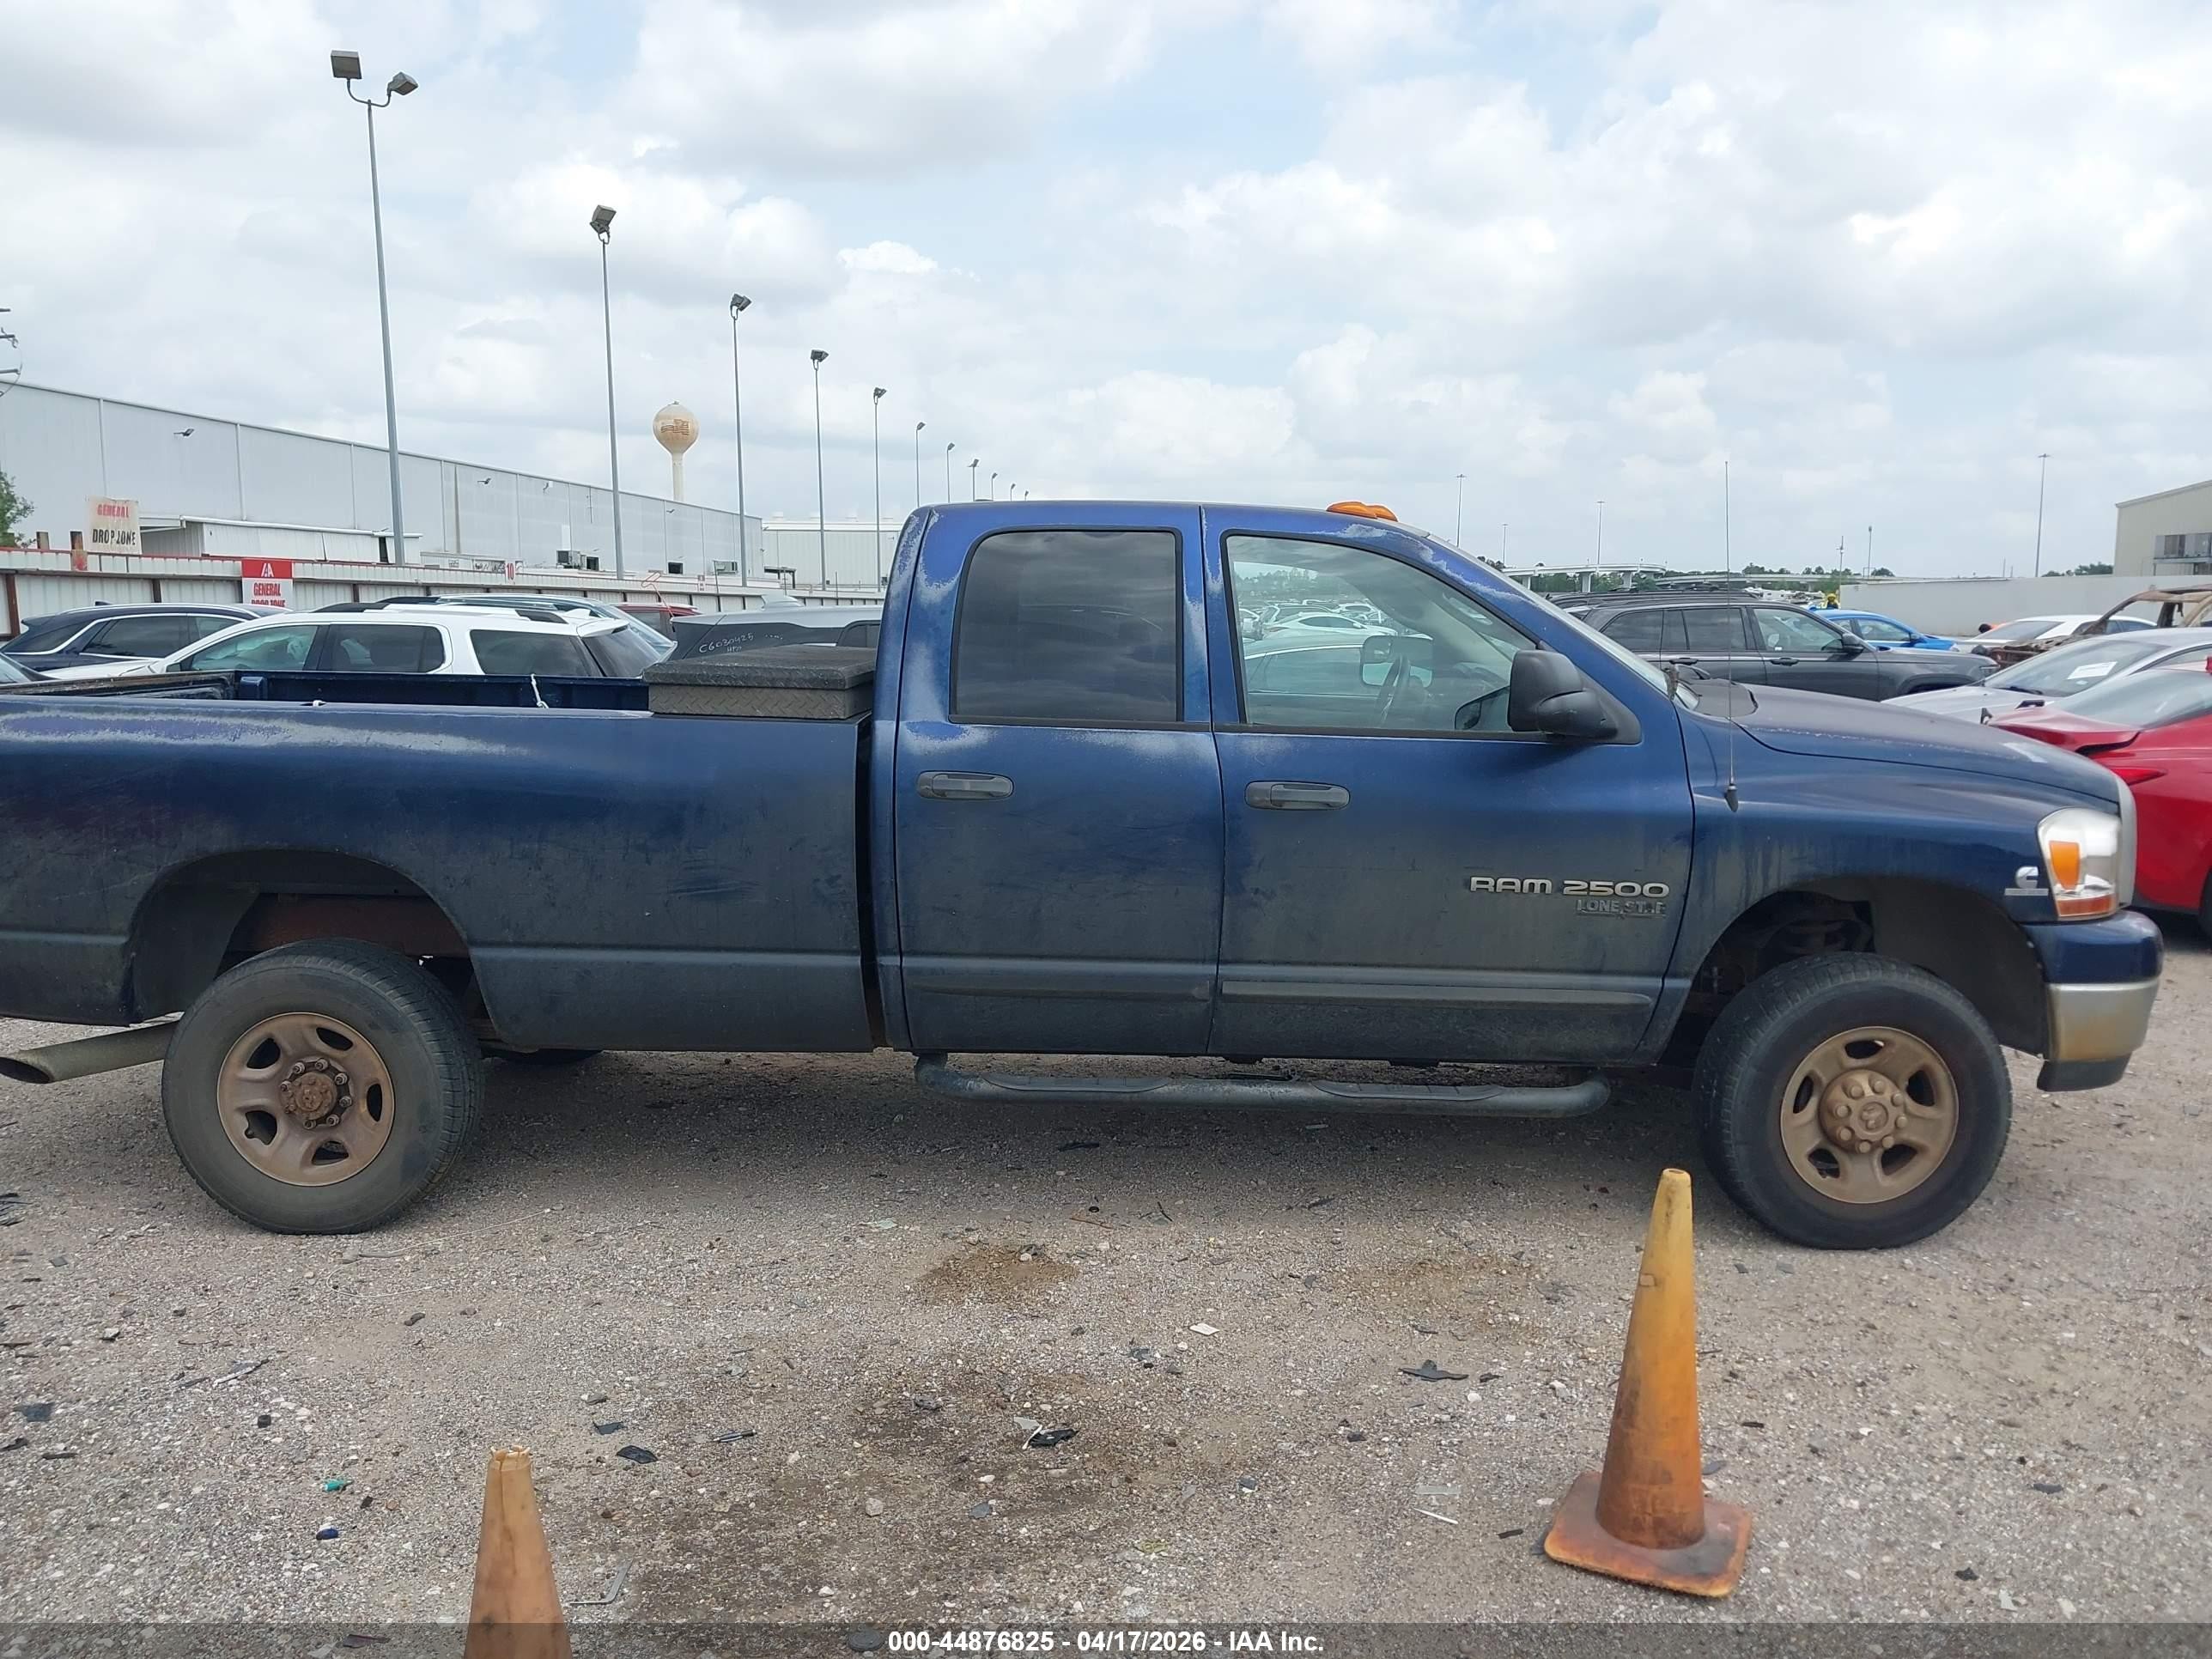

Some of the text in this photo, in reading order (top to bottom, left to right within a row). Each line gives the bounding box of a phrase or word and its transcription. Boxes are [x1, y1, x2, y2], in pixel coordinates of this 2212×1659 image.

[92, 528, 136, 545] DROP ZONE
[506, 562, 515, 580] 10
[253, 582, 282, 597] GENERAL
[1469, 876, 1670, 898] RAM 2500
